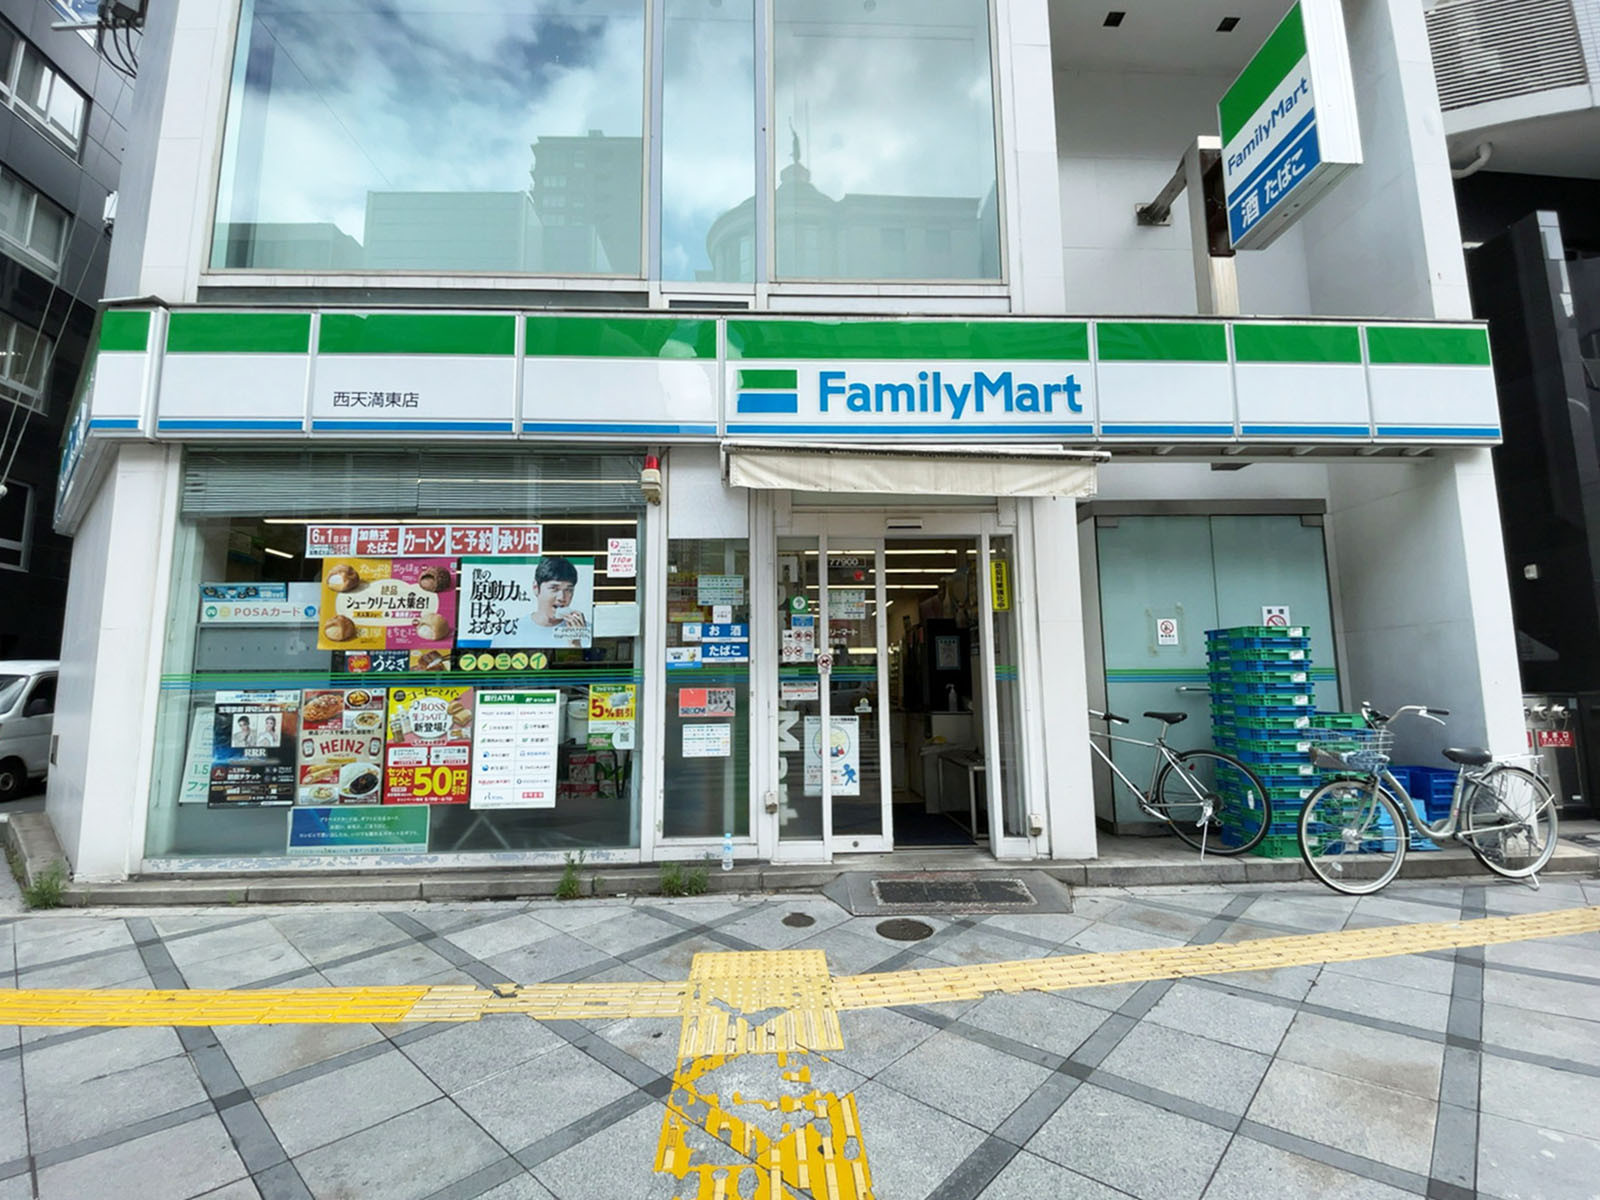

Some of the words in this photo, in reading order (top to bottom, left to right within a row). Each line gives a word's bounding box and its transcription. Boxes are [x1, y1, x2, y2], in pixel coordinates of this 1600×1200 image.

[1227, 76, 1308, 177] FamilyMart
[1240, 188, 1260, 229] 酒
[1263, 147, 1306, 205] たばこ
[333, 391, 419, 409] 西天満東店
[819, 370, 1083, 420] FamilyMart
[367, 543, 399, 555] たばこ
[404, 530, 446, 553] カートン
[451, 529, 493, 553] ご予約
[498, 529, 540, 553] 承り中
[472, 568, 491, 581] 僕の
[234, 607, 301, 617] POSAカード
[471, 602, 506, 620] 日本の
[709, 645, 741, 656] たばこ
[421, 703, 447, 711] BOSS
[245, 748, 267, 757] RRR
[320, 739, 364, 755] HEINZ
